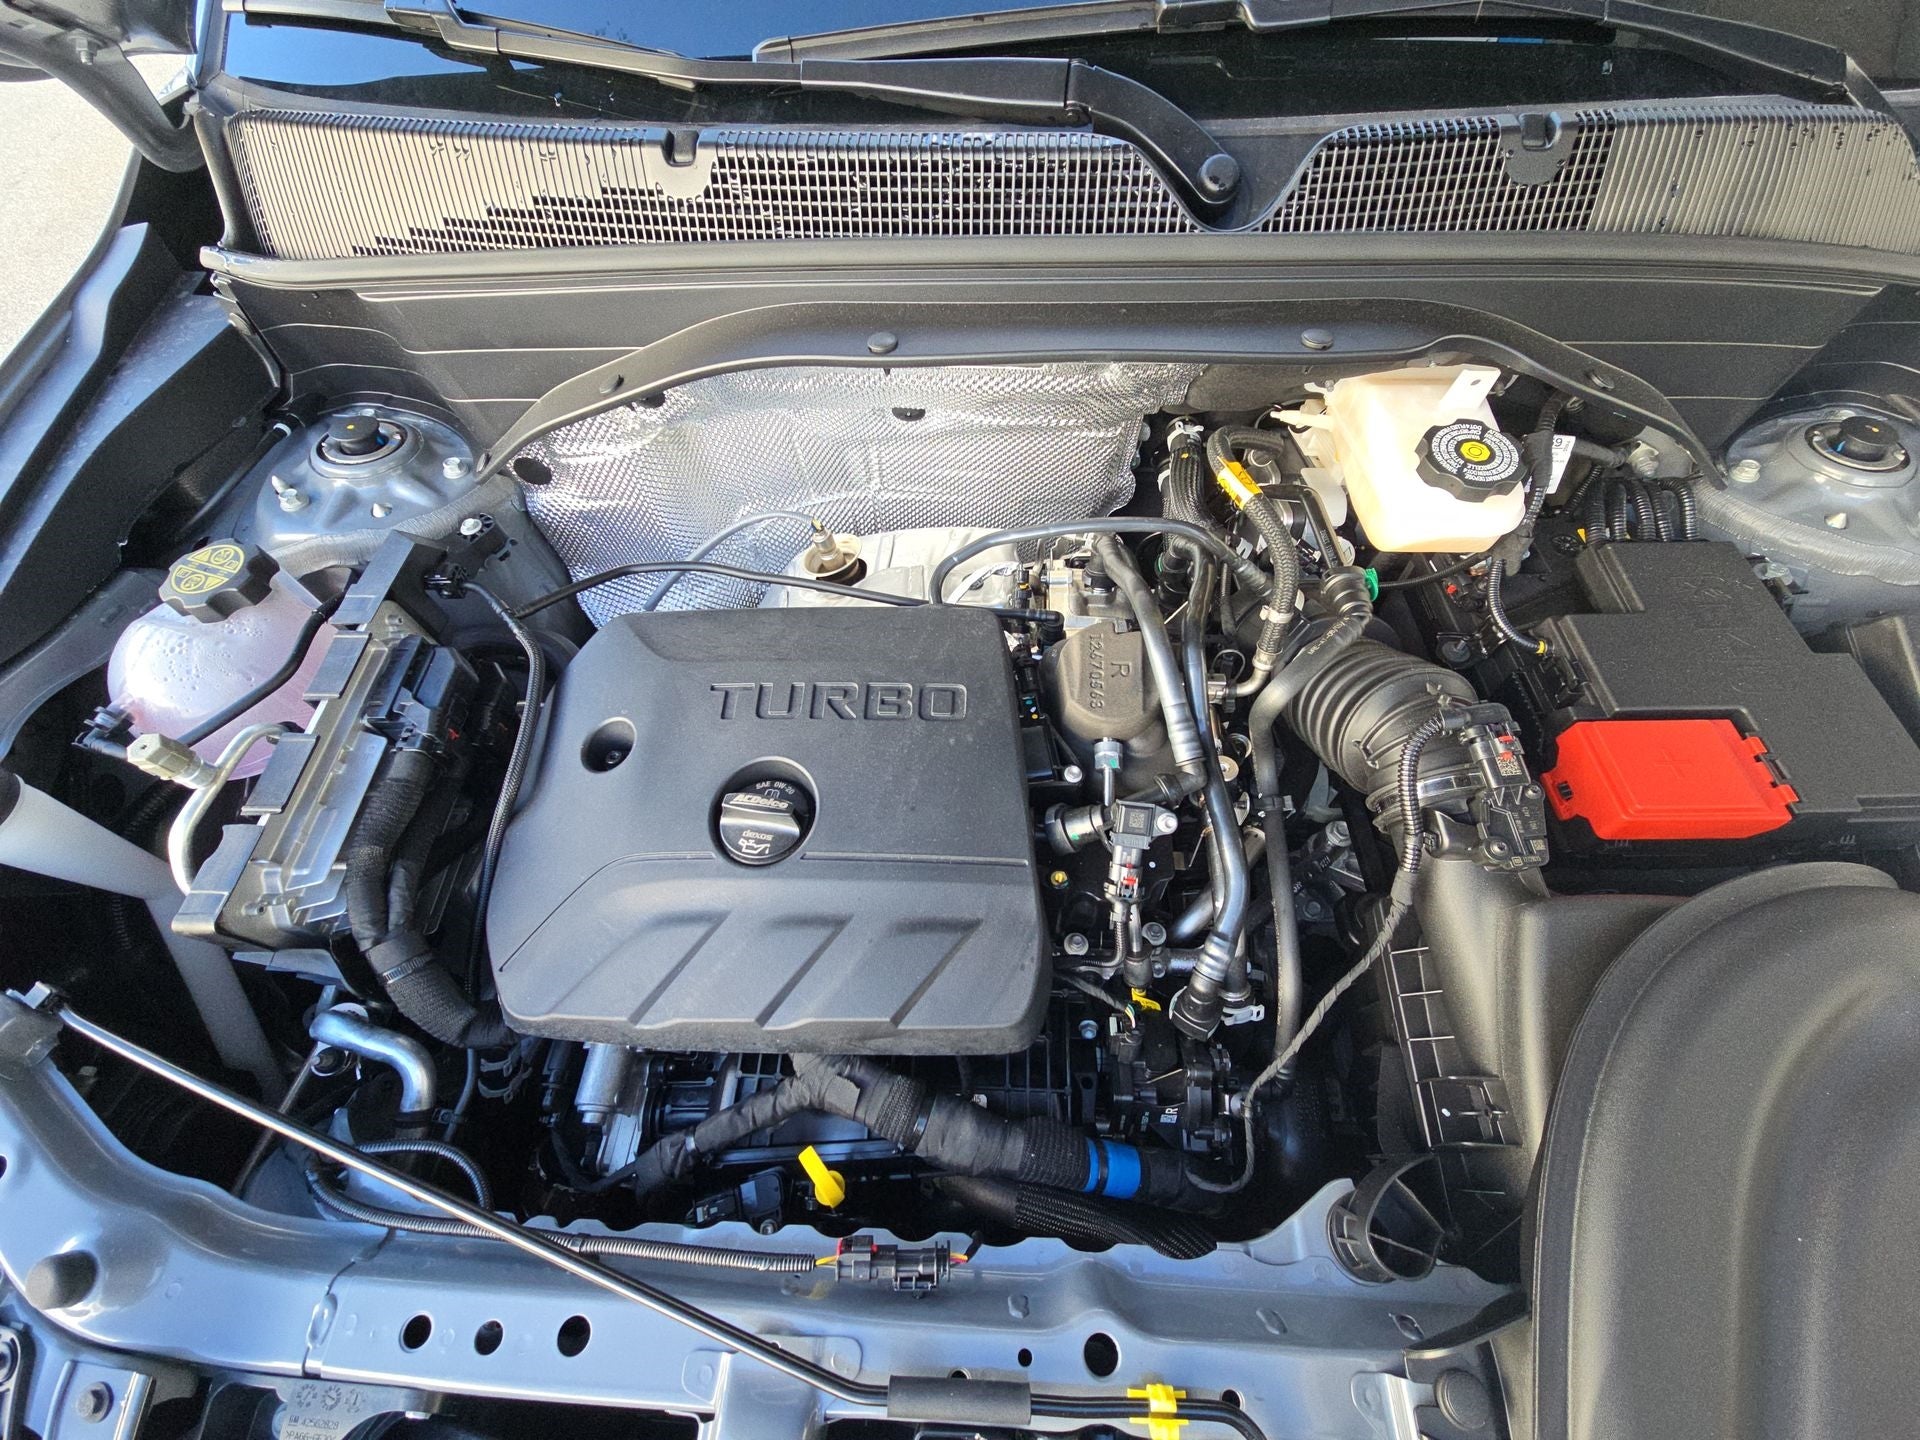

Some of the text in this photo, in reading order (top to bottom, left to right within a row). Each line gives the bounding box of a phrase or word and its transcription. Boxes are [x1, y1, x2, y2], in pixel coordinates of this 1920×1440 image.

[1111, 662, 1132, 678] R
[710, 682, 968, 720] TURBO
[756, 781, 795, 795] SAE 0W-20
[731, 793, 789, 810] ACDelco
[742, 829, 774, 841] dexos
